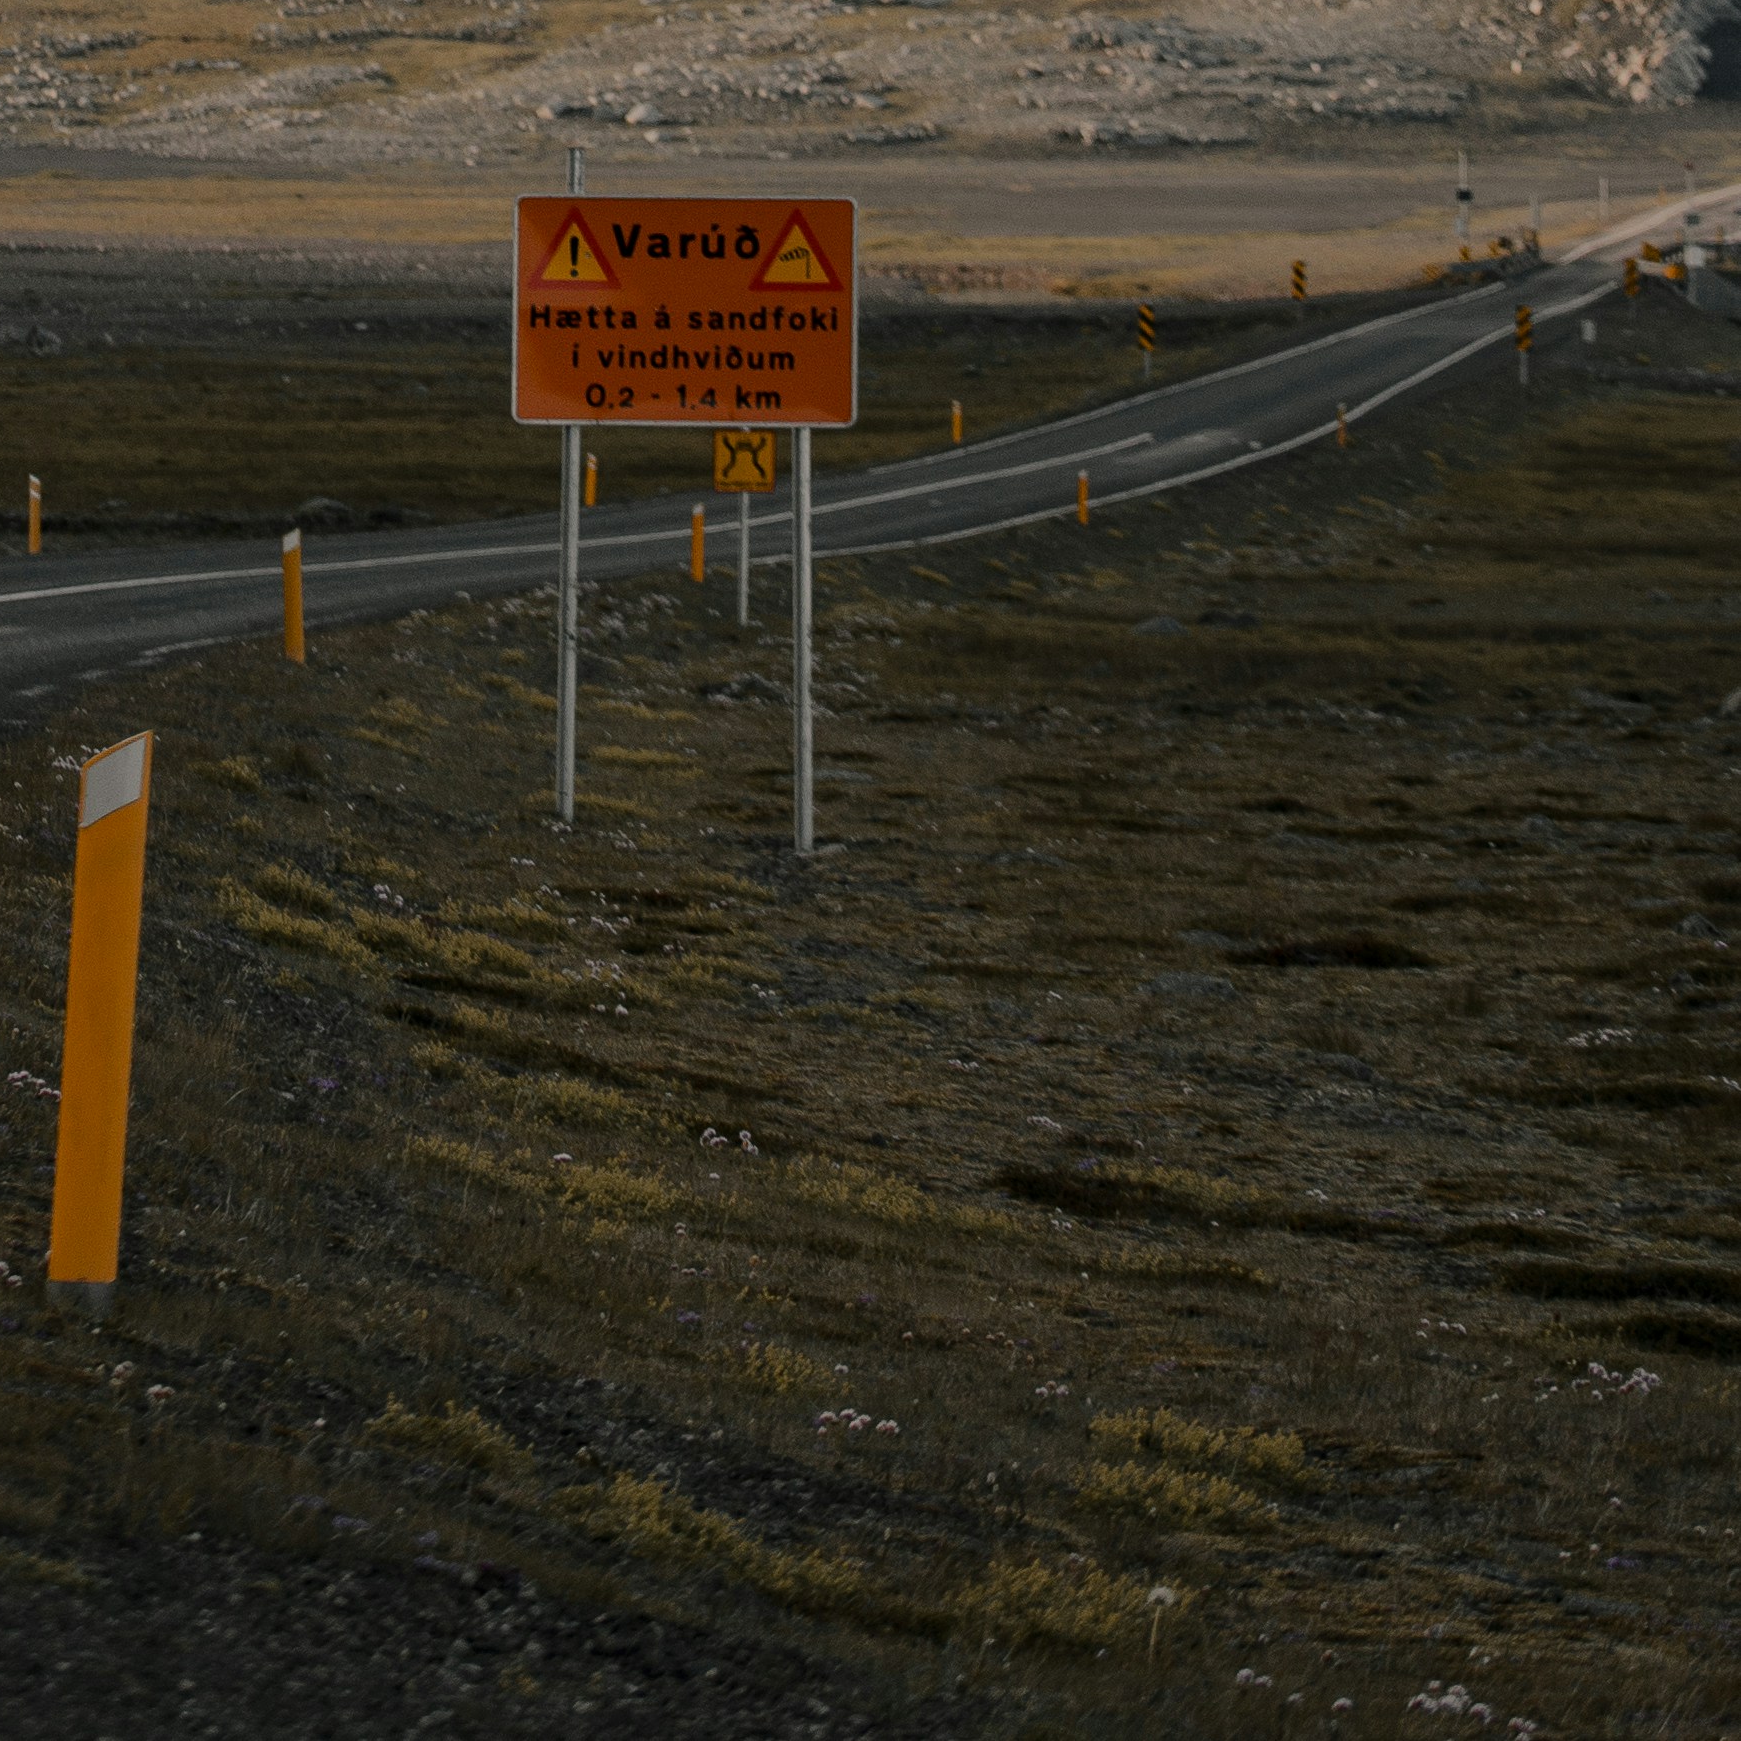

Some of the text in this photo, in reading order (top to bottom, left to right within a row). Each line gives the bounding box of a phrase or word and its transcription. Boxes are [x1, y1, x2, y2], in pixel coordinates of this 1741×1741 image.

[611, 222, 761, 260] Varúð
[529, 304, 839, 332] Hætta á sandfoki
[596, 343, 796, 371] vindhviðum
[734, 383, 783, 409] km
